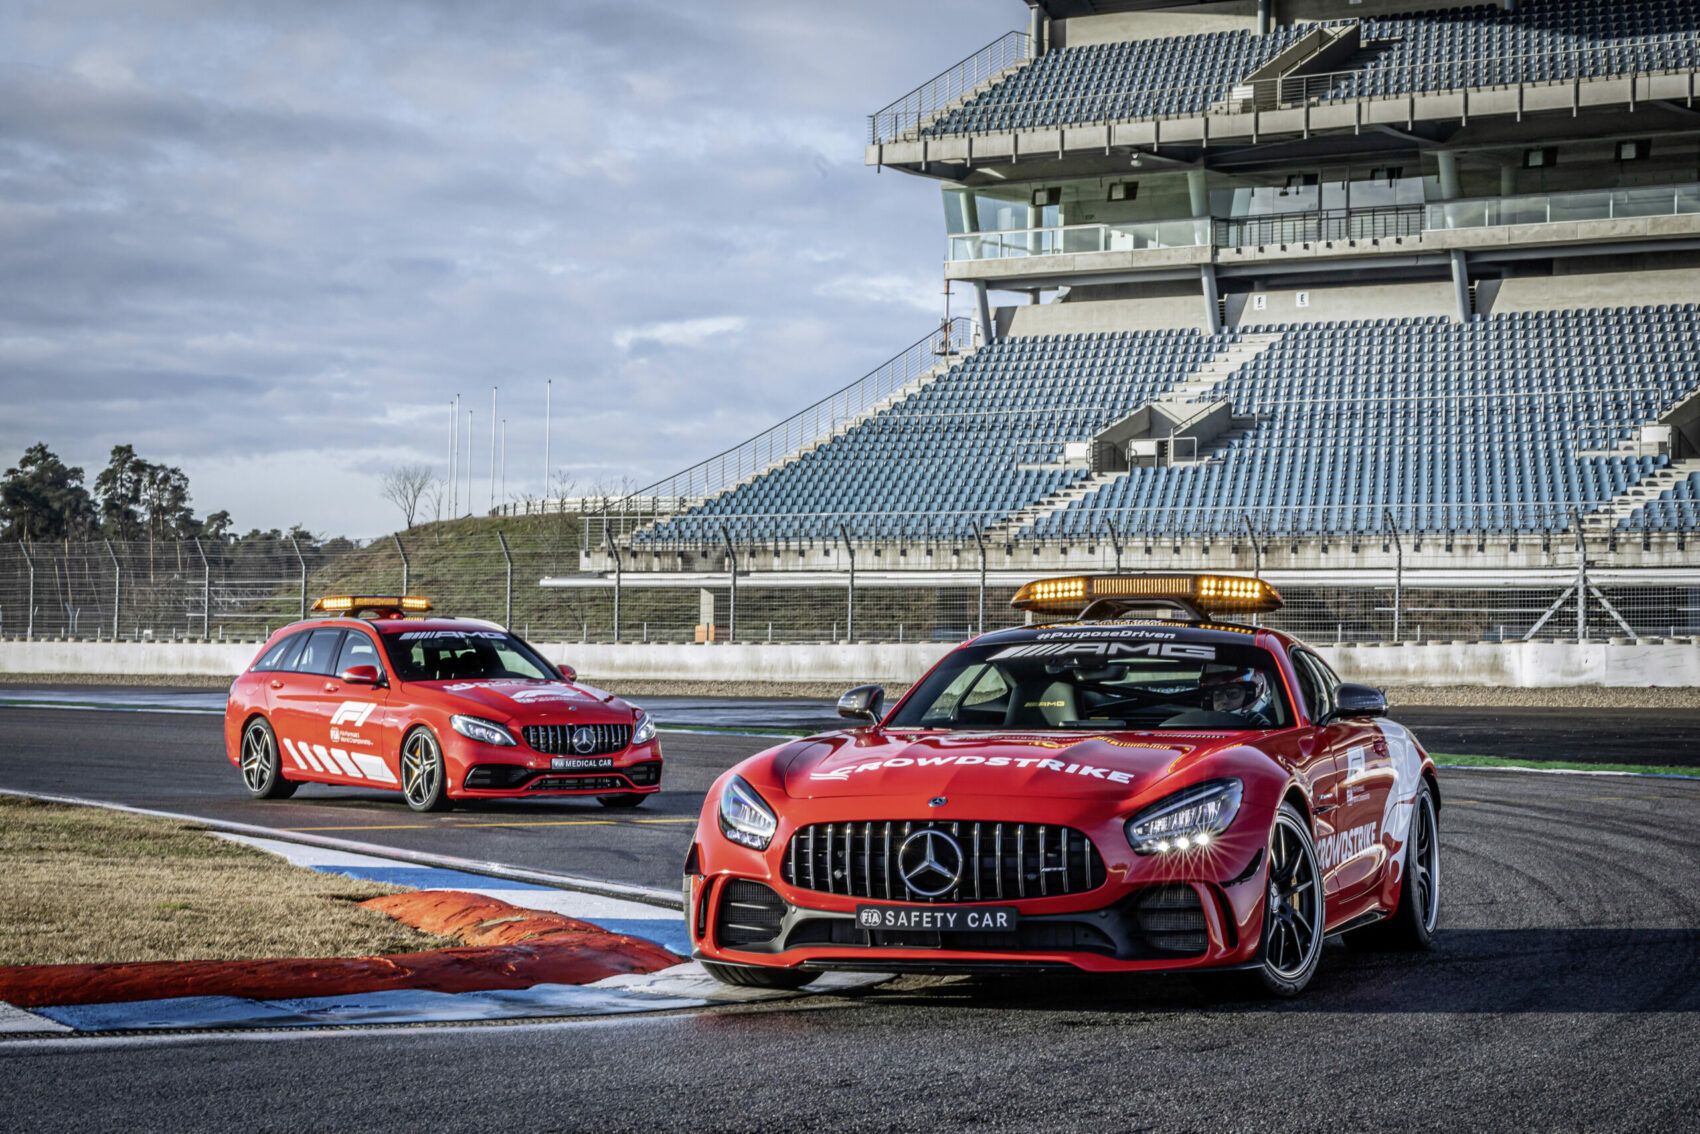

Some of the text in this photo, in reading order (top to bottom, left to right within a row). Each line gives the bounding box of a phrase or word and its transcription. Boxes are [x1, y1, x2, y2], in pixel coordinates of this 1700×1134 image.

[433, 631, 508, 640] AMG
[1036, 630, 1176, 641] #PurposeDriven
[1053, 642, 1216, 660] AMG
[565, 759, 597, 768] MEDICAL
[598, 759, 612, 767] CAR
[810, 755, 1135, 785] CROWDSTRIKE
[861, 910, 1008, 928] FIA SAFETY CAR
